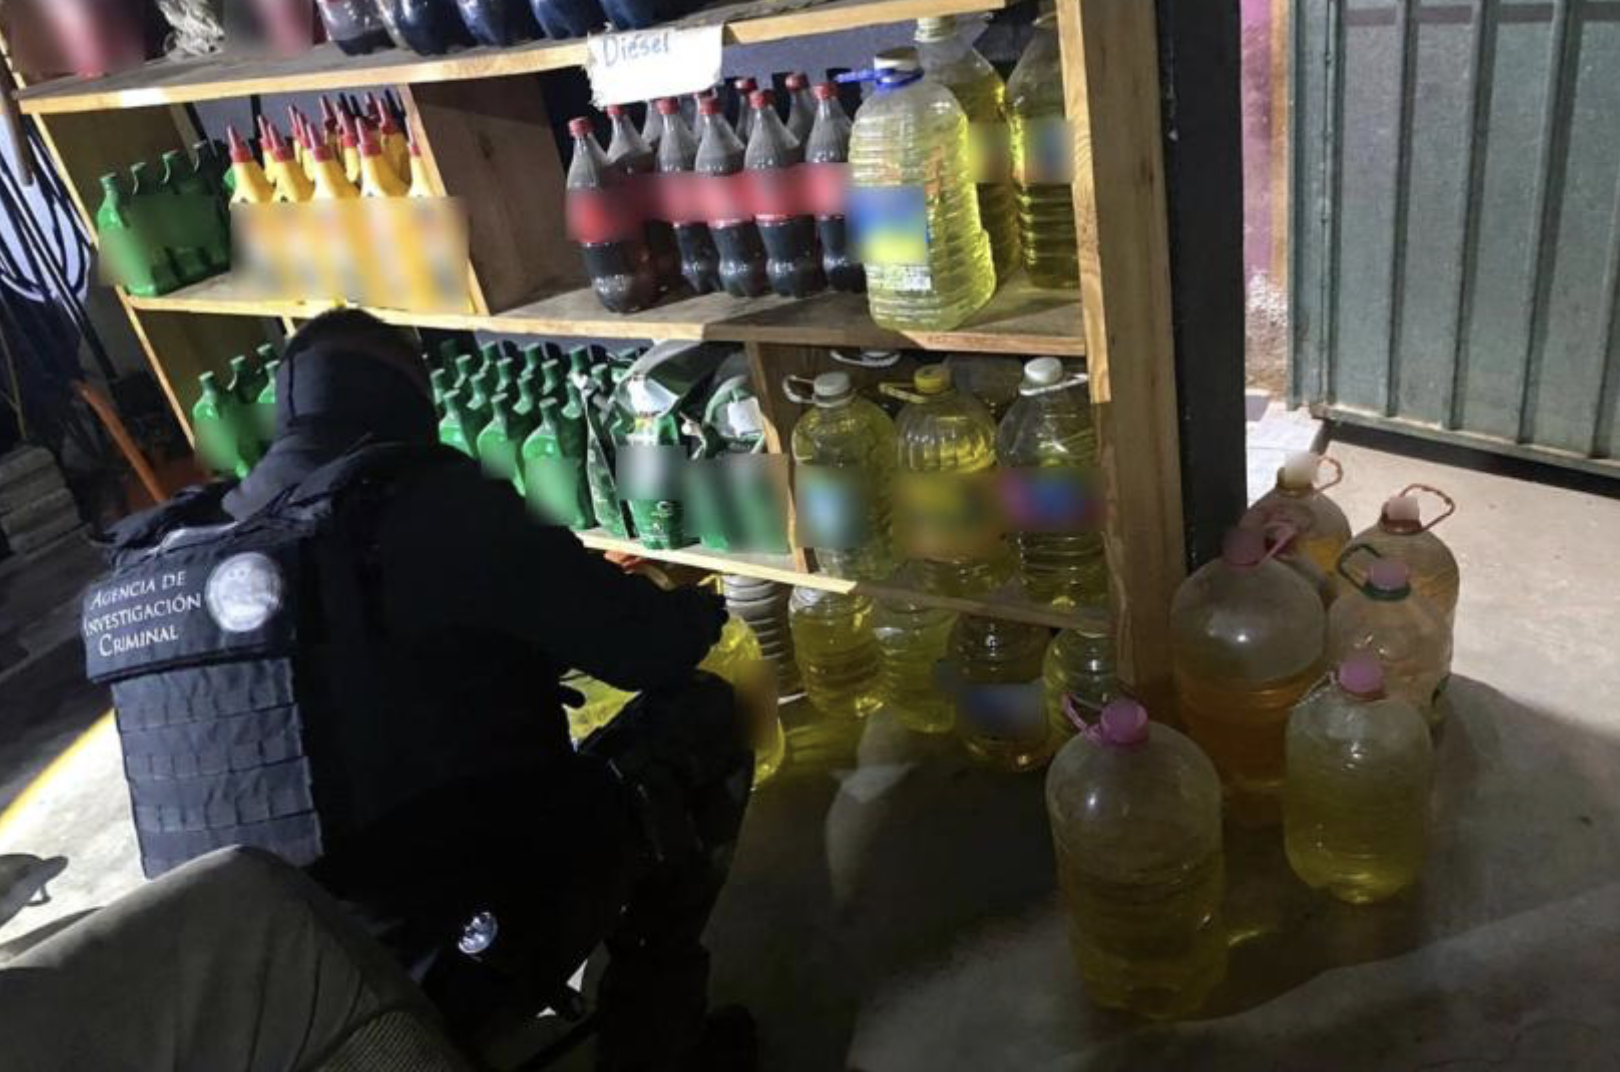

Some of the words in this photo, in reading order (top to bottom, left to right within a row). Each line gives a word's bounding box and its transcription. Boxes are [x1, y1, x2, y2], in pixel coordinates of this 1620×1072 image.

[89, 578, 156, 610] AGENCIA
[162, 571, 187, 589] DE
[84, 593, 201, 637] INVESTIGACIÓN
[99, 625, 179, 657] CRIMINAL
